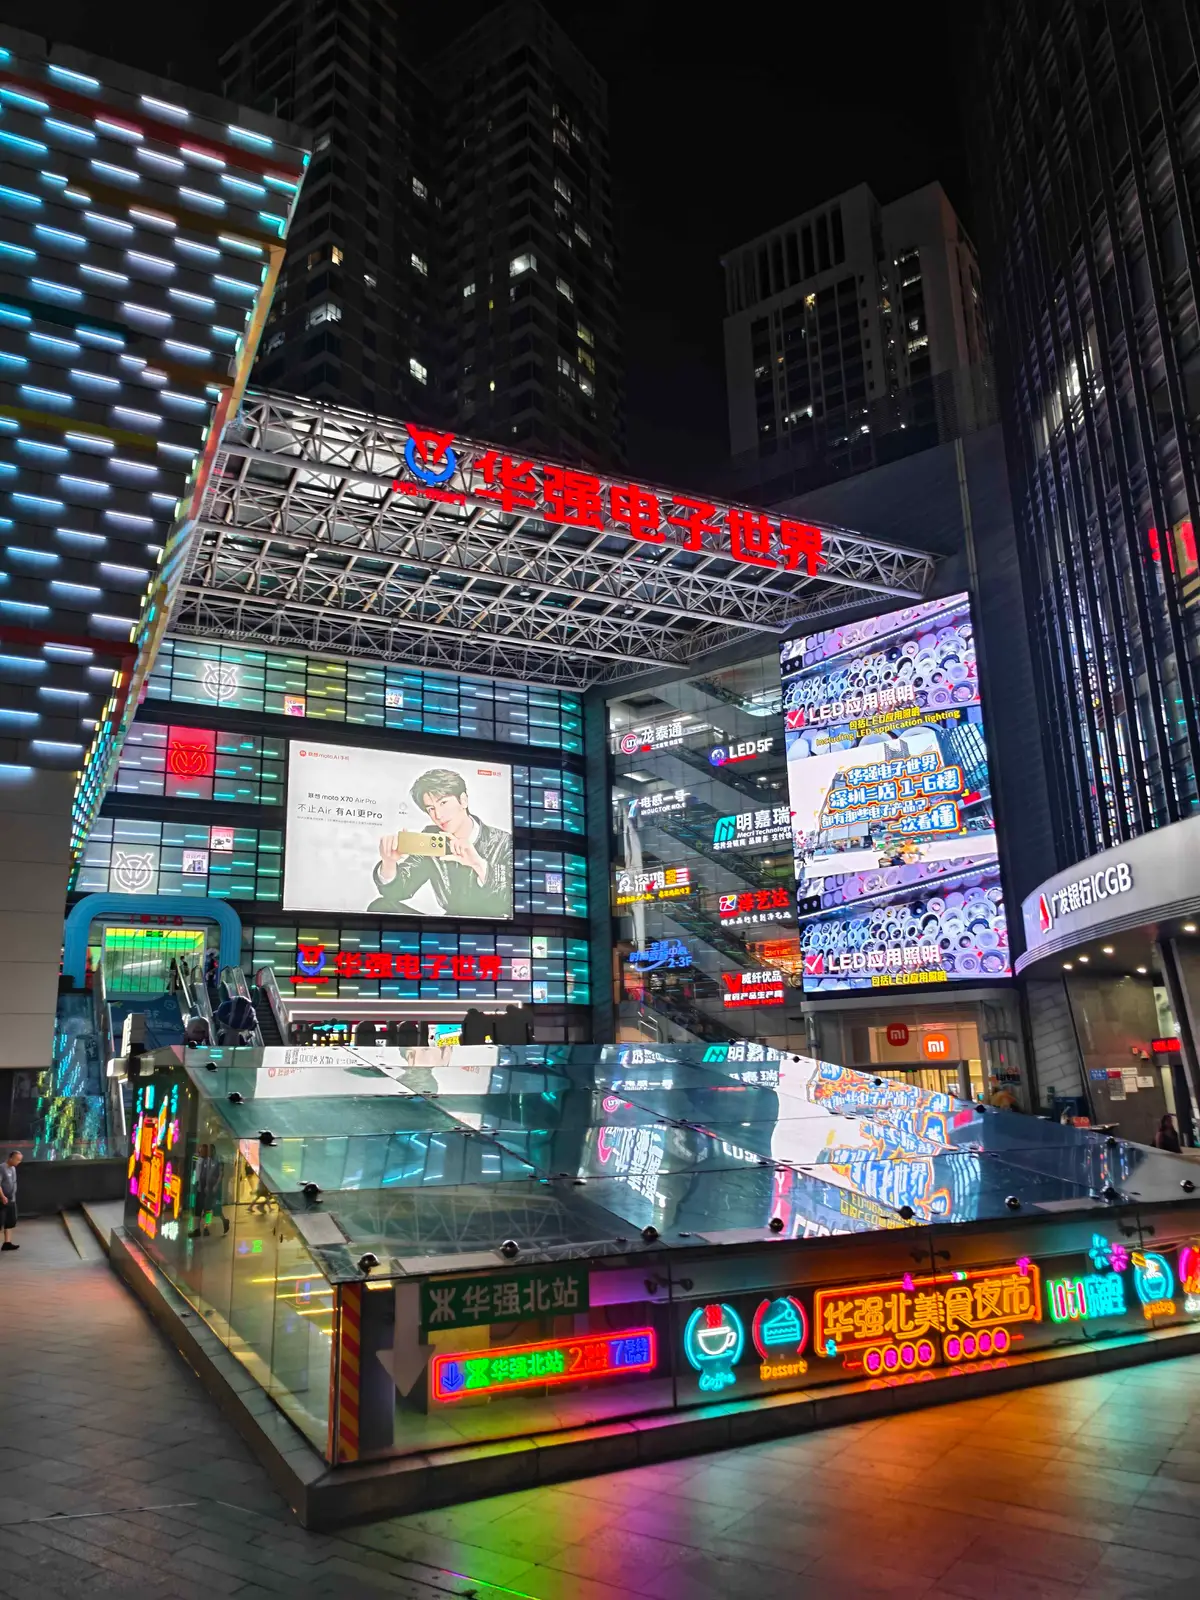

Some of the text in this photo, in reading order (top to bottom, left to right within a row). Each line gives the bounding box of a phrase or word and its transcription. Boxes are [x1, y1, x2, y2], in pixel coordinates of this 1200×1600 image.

[474, 449, 828, 577] 华强电子世界
[808, 684, 915, 723] LED应用照明
[849, 706, 921, 730] 包括LED应用照明
[641, 722, 683, 745] 龙泰通
[856, 727, 872, 738] LED
[873, 718, 923, 736] application
[924, 709, 960, 723] lighting
[728, 737, 774, 759] LED 5F
[847, 754, 938, 785] 华强电子世界
[829, 769, 959, 808] 深圳三店 1-6楼
[736, 806, 791, 831] 明嘉瑞
[755, 826, 792, 836] Technology
[891, 804, 955, 832] 一次看懂
[1051, 862, 1132, 917] 广发银行 CGB
[333, 951, 504, 981] 华强电子世界
[668, 956, 693, 968] 2-3F
[828, 945, 941, 971] LED应用照明
[871, 970, 948, 987] 包括LED应用照明
[460, 1275, 580, 1320] 华强北站
[823, 1274, 1033, 1343] 华强北美食夜市
[490, 1351, 565, 1381] 华强北站
